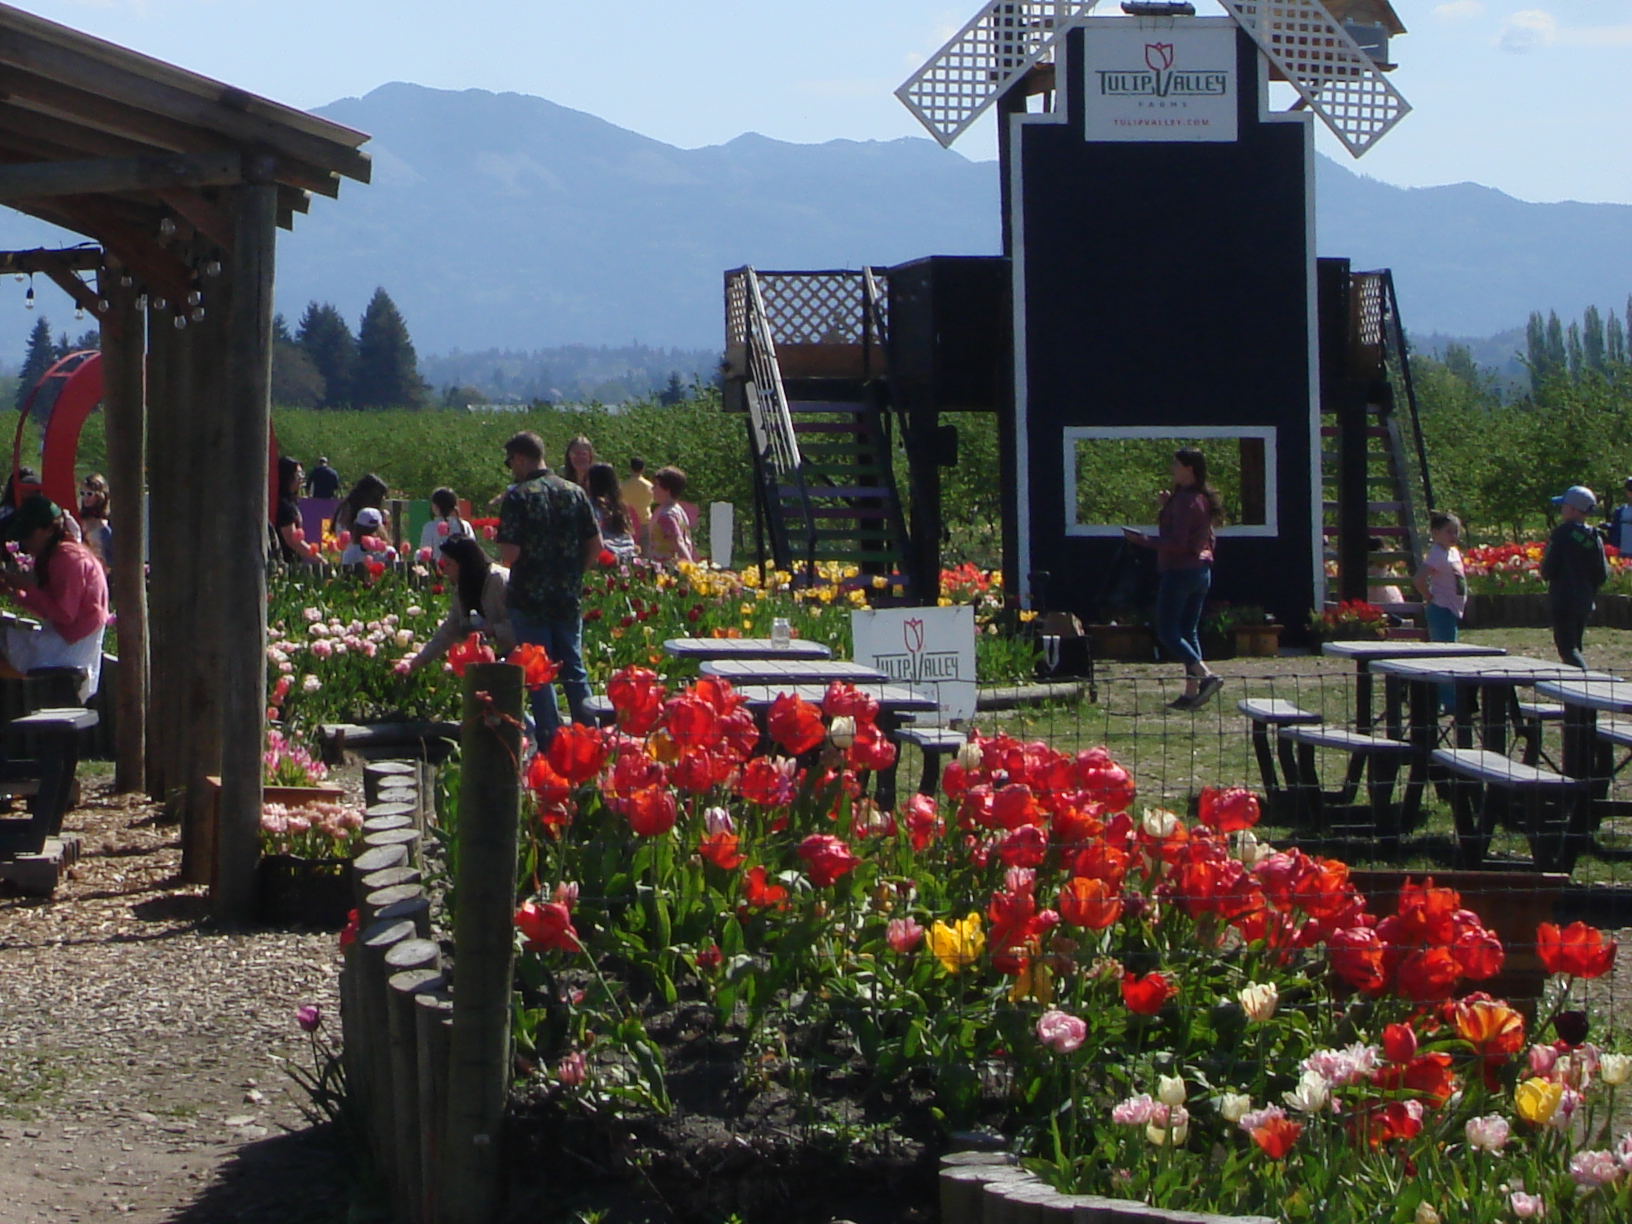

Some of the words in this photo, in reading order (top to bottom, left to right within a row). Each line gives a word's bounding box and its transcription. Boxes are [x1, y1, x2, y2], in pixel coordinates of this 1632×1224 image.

[1095, 70, 1154, 96] TULIP
[1154, 70, 1228, 97] VALLEY
[911, 651, 959, 685] VALLEY
